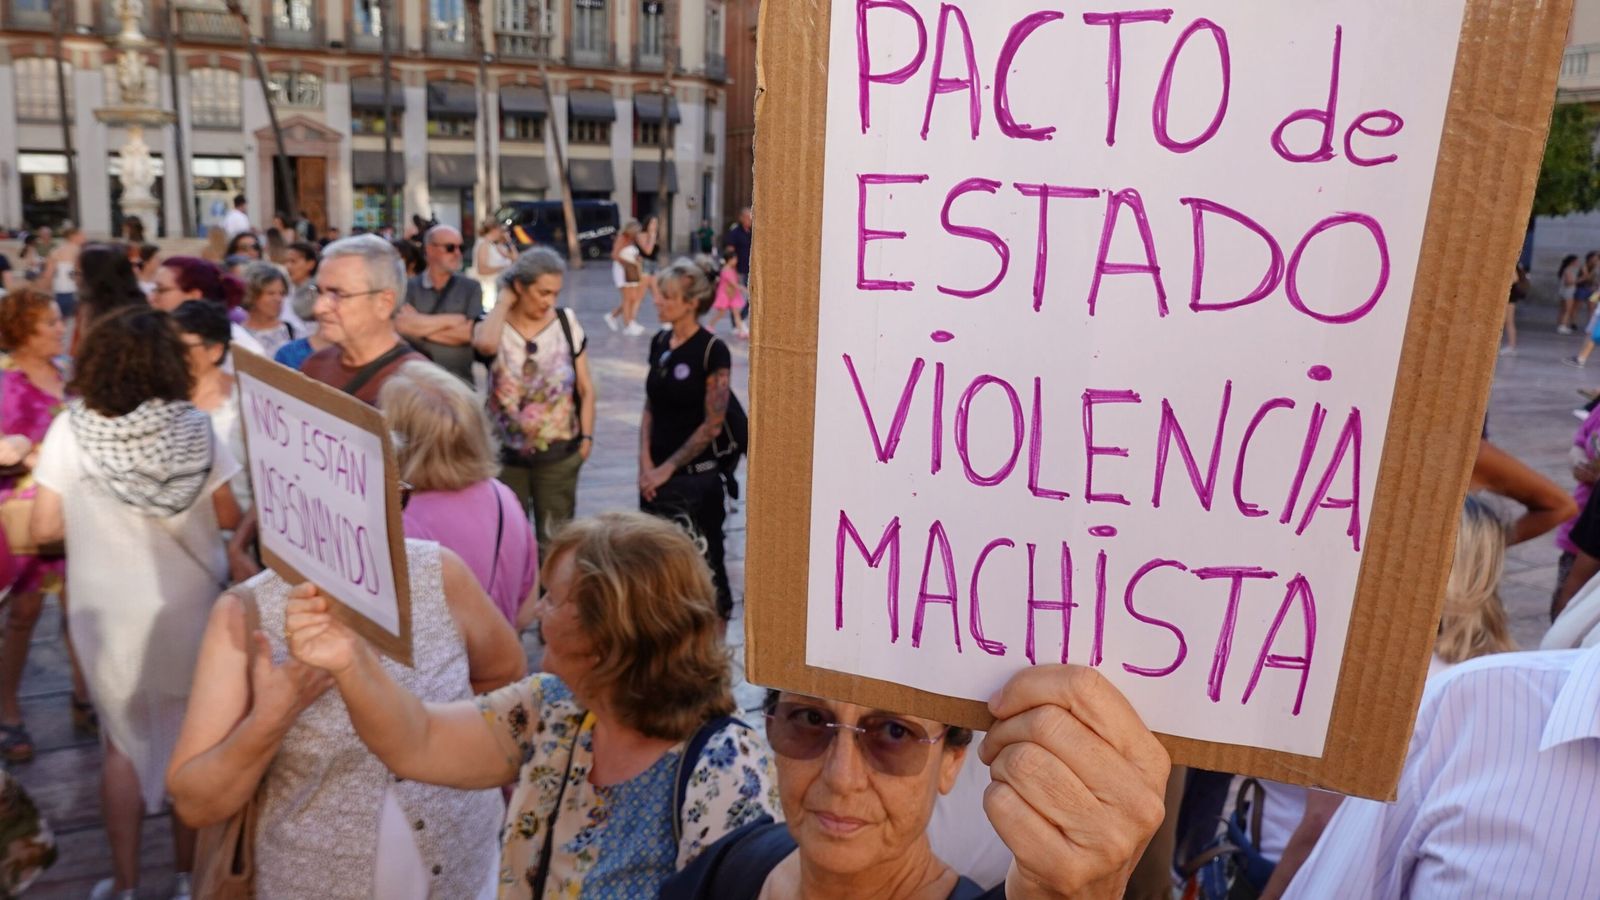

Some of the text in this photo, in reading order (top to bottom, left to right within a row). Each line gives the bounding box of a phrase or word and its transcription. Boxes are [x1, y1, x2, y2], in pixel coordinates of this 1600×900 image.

[856, 0, 1405, 166] PACTO de
[857, 173, 1391, 324] ESTADO
[251, 390, 368, 501] NOS ESTÁN
